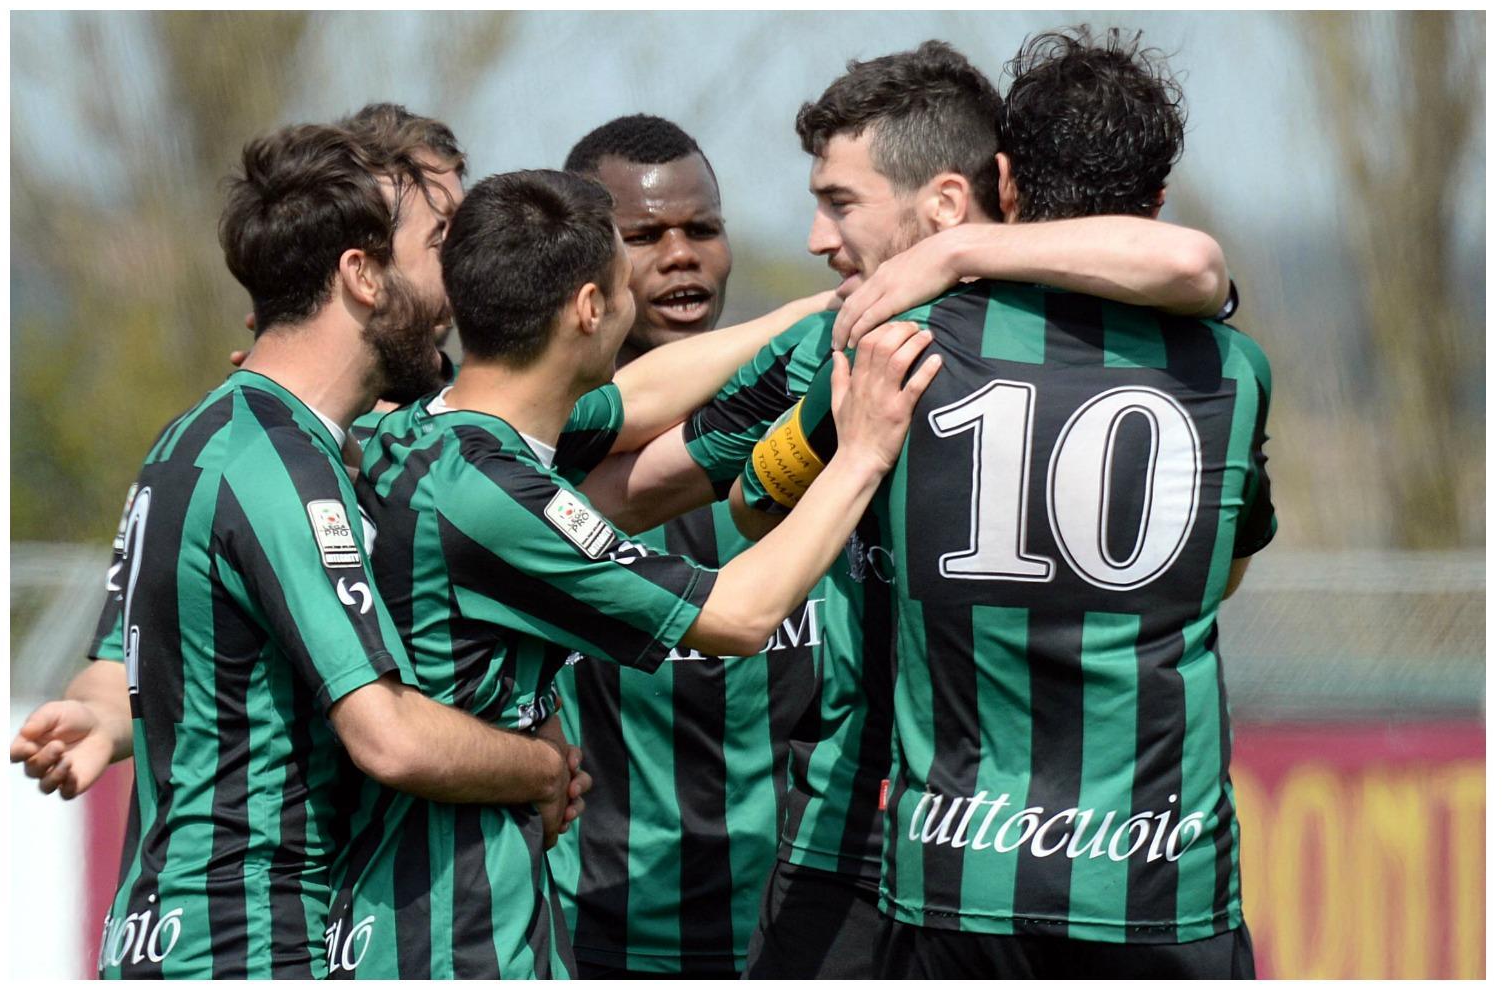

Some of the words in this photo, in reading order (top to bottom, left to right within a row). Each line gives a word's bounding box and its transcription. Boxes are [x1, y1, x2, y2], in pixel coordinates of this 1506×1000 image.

[928, 379, 1203, 592] 10
[324, 528, 349, 538] PRO
[907, 784, 1205, 864] tuttocuoio
